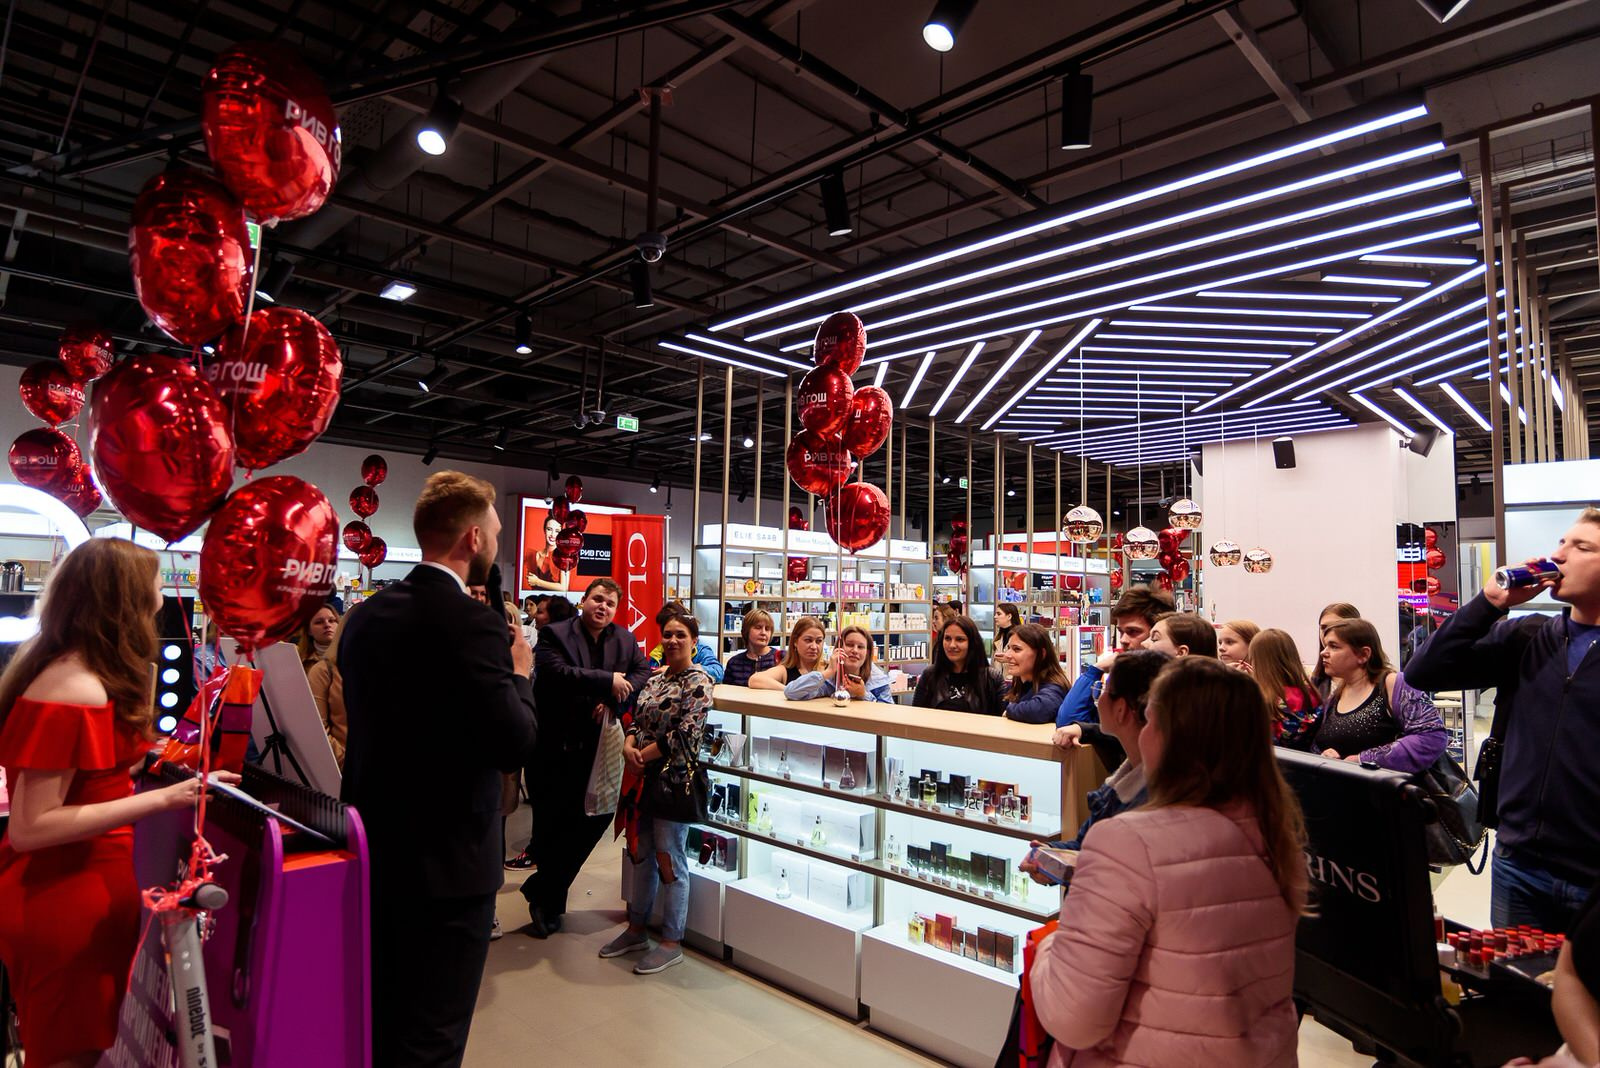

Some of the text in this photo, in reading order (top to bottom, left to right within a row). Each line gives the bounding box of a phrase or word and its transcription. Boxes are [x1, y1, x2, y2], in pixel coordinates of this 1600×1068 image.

[286, 99, 328, 146] РИВ
[221, 361, 269, 382] ГОШ
[805, 392, 828, 405] ГОШ
[733, 530, 778, 543] ELIE SAAB
[579, 549, 611, 558] РИВ ГОШ
[283, 558, 324, 584] РИВ
[627, 532, 648, 657] CLA
[185, 985, 207, 1041] ninebot
